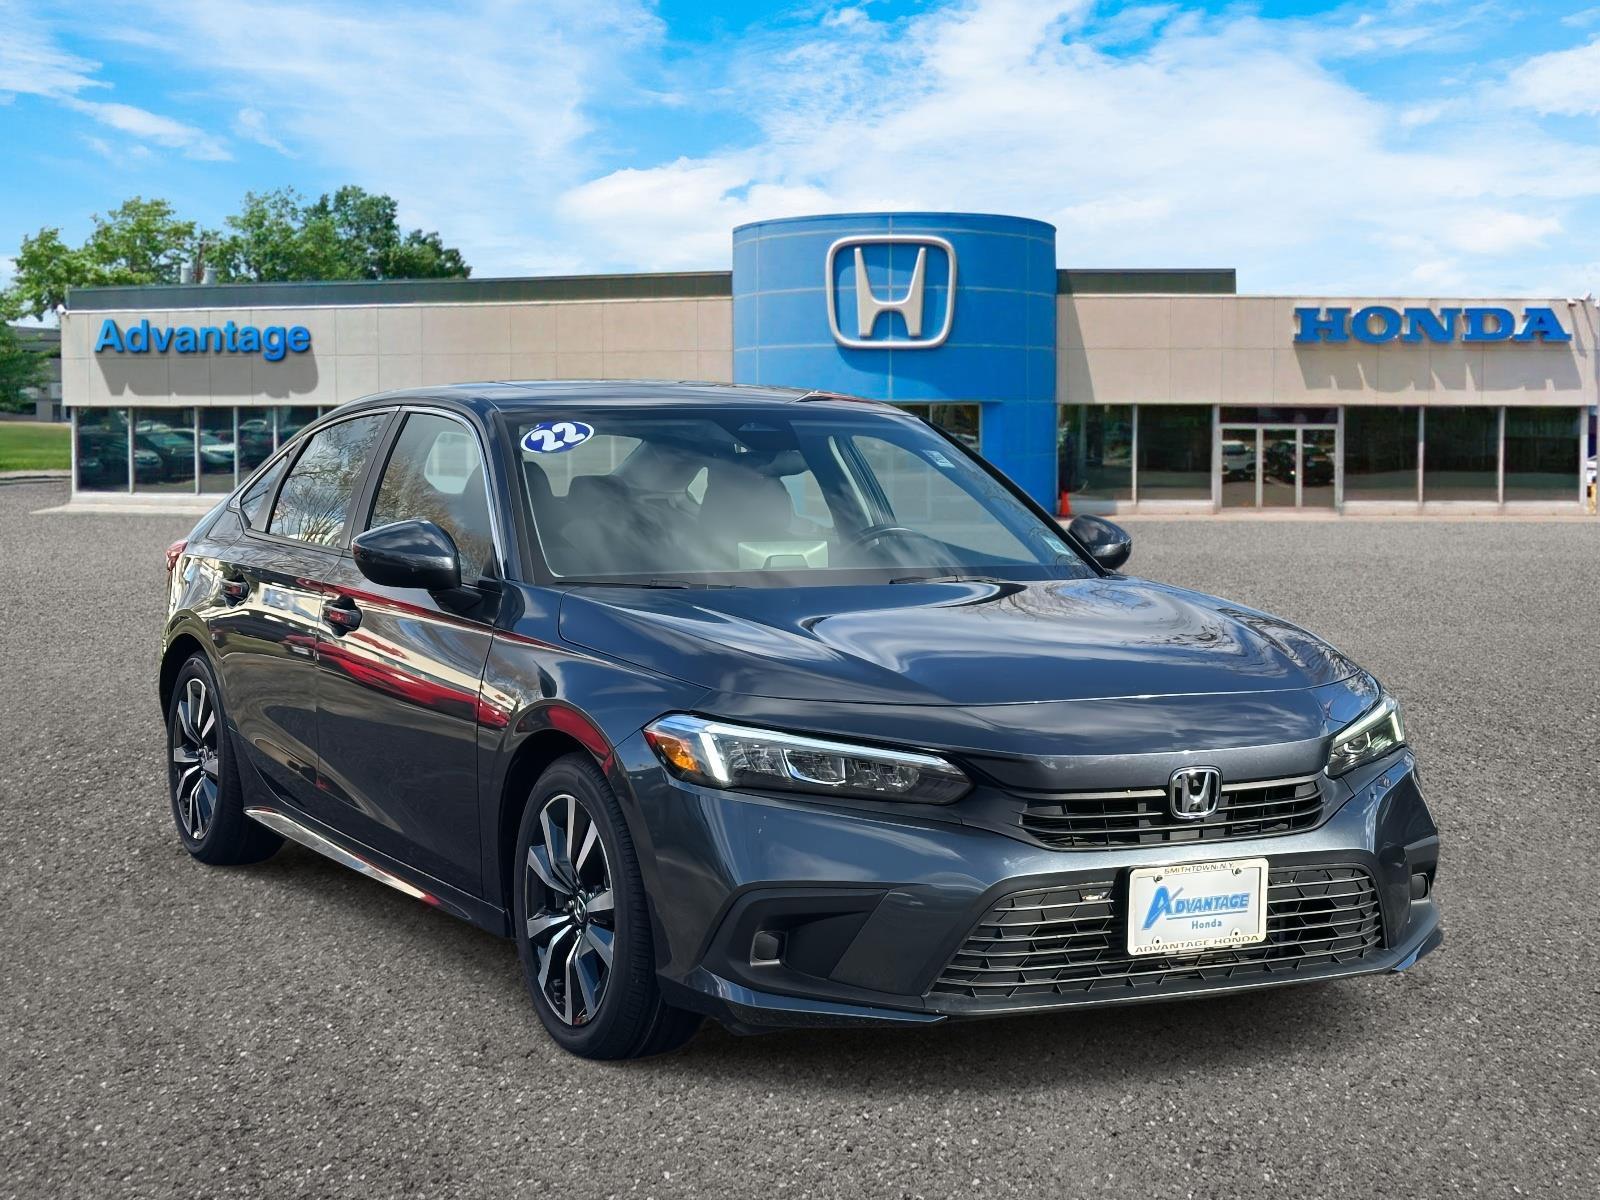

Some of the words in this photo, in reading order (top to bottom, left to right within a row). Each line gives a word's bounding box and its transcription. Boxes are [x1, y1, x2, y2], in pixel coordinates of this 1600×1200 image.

[95, 318, 312, 361] Advantage
[1294, 306, 1572, 344] HONDA
[530, 422, 586, 451] 22
[1191, 919, 1222, 930] Honda
[1135, 941, 1209, 953] ADVANTAGE
[1214, 935, 1259, 945] HONDA
